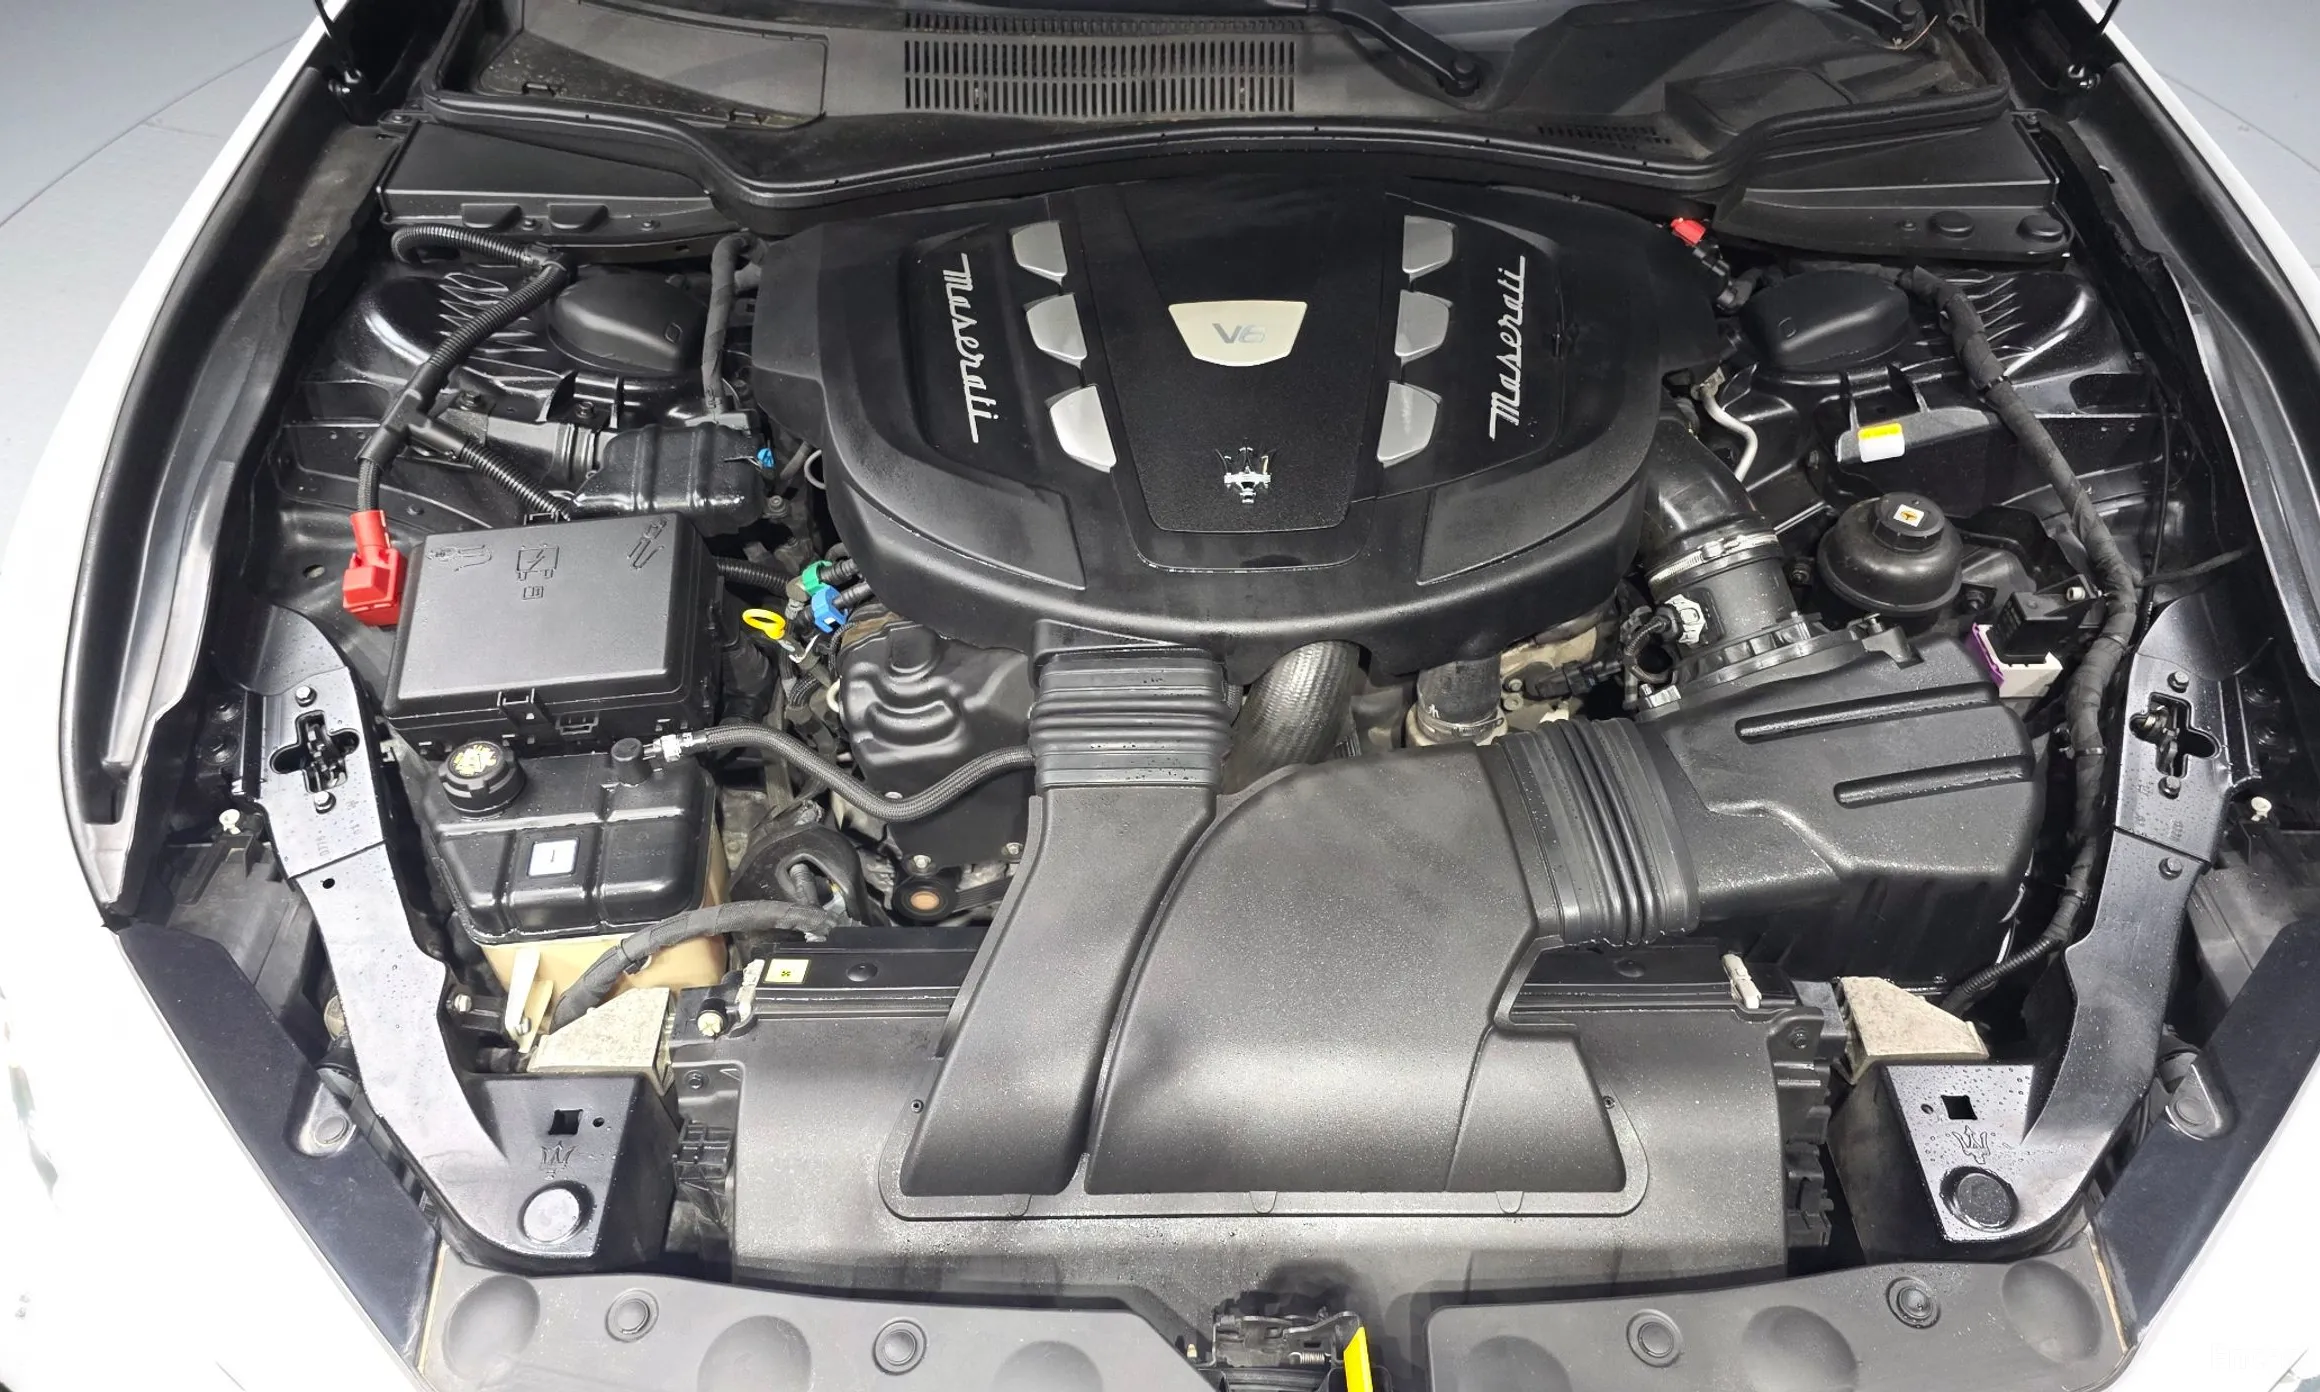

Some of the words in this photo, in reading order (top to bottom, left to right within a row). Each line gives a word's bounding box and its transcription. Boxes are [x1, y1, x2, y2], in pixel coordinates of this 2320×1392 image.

[942, 252, 999, 444] Maserati
[1212, 322, 1267, 345] V6
[1488, 255, 1526, 441] Maserati
